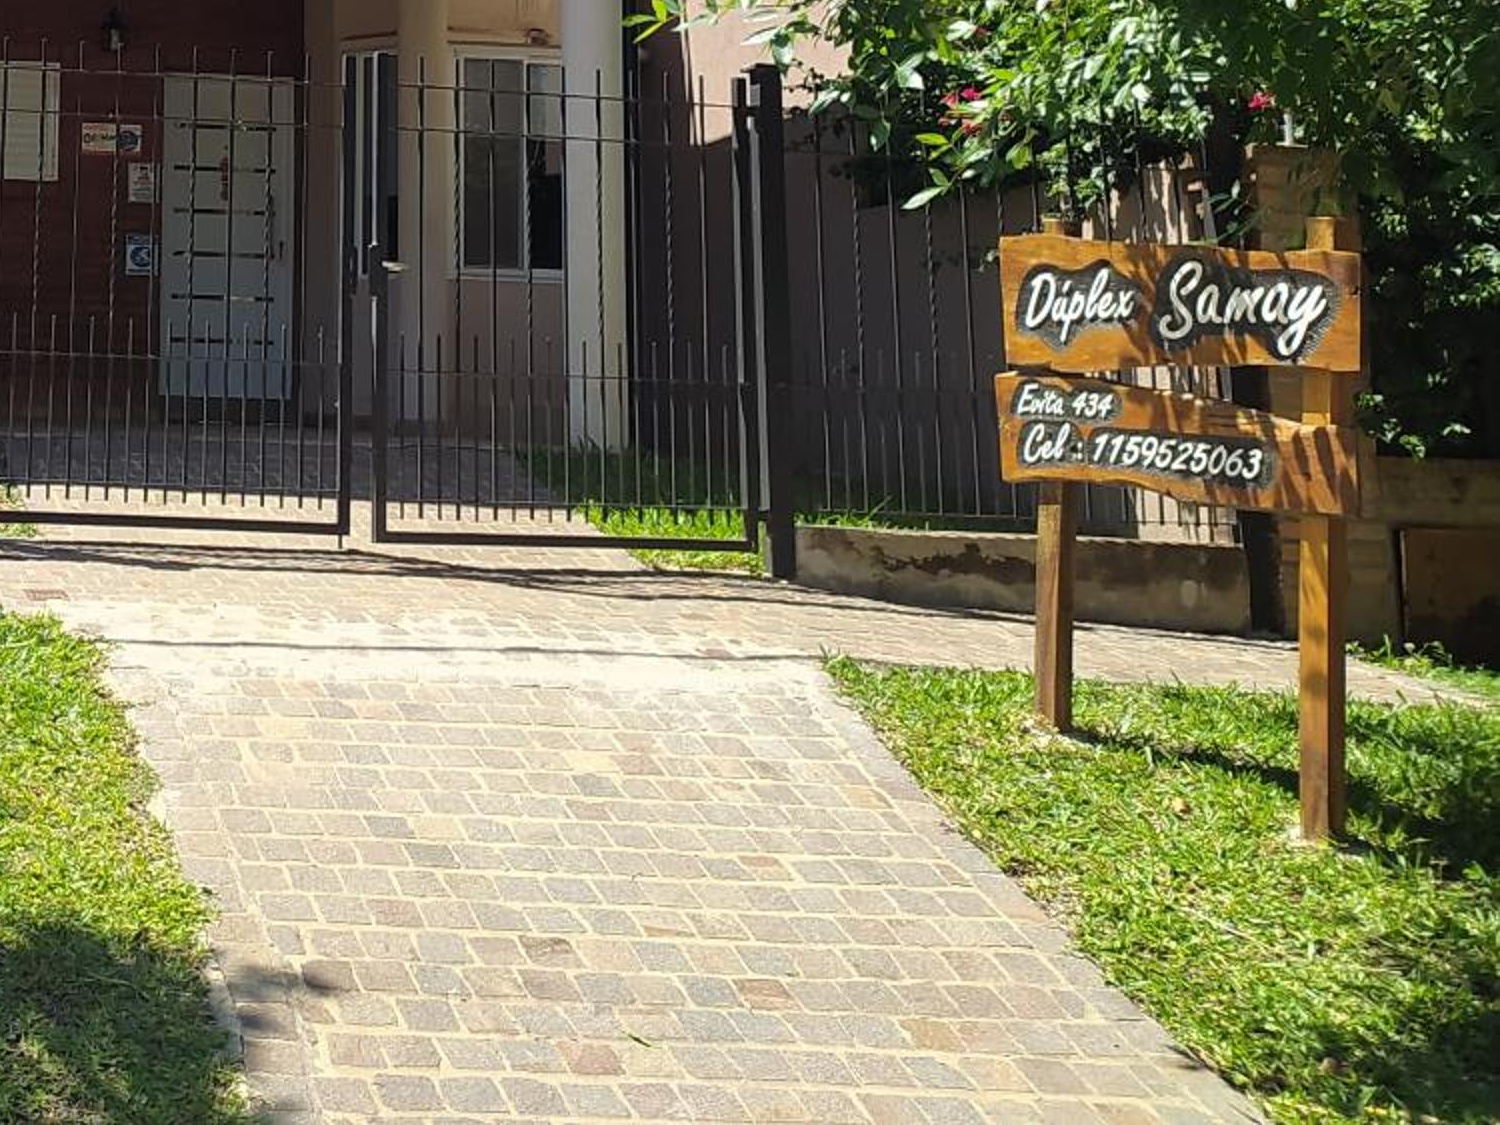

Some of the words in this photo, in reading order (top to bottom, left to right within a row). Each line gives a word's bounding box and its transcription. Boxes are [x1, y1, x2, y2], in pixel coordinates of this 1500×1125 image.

[1159, 261, 1328, 357] Samay
[1017, 383, 1065, 415] Evita
[1071, 391, 1113, 418] 434
[1093, 432, 1263, 480] 1159525063
